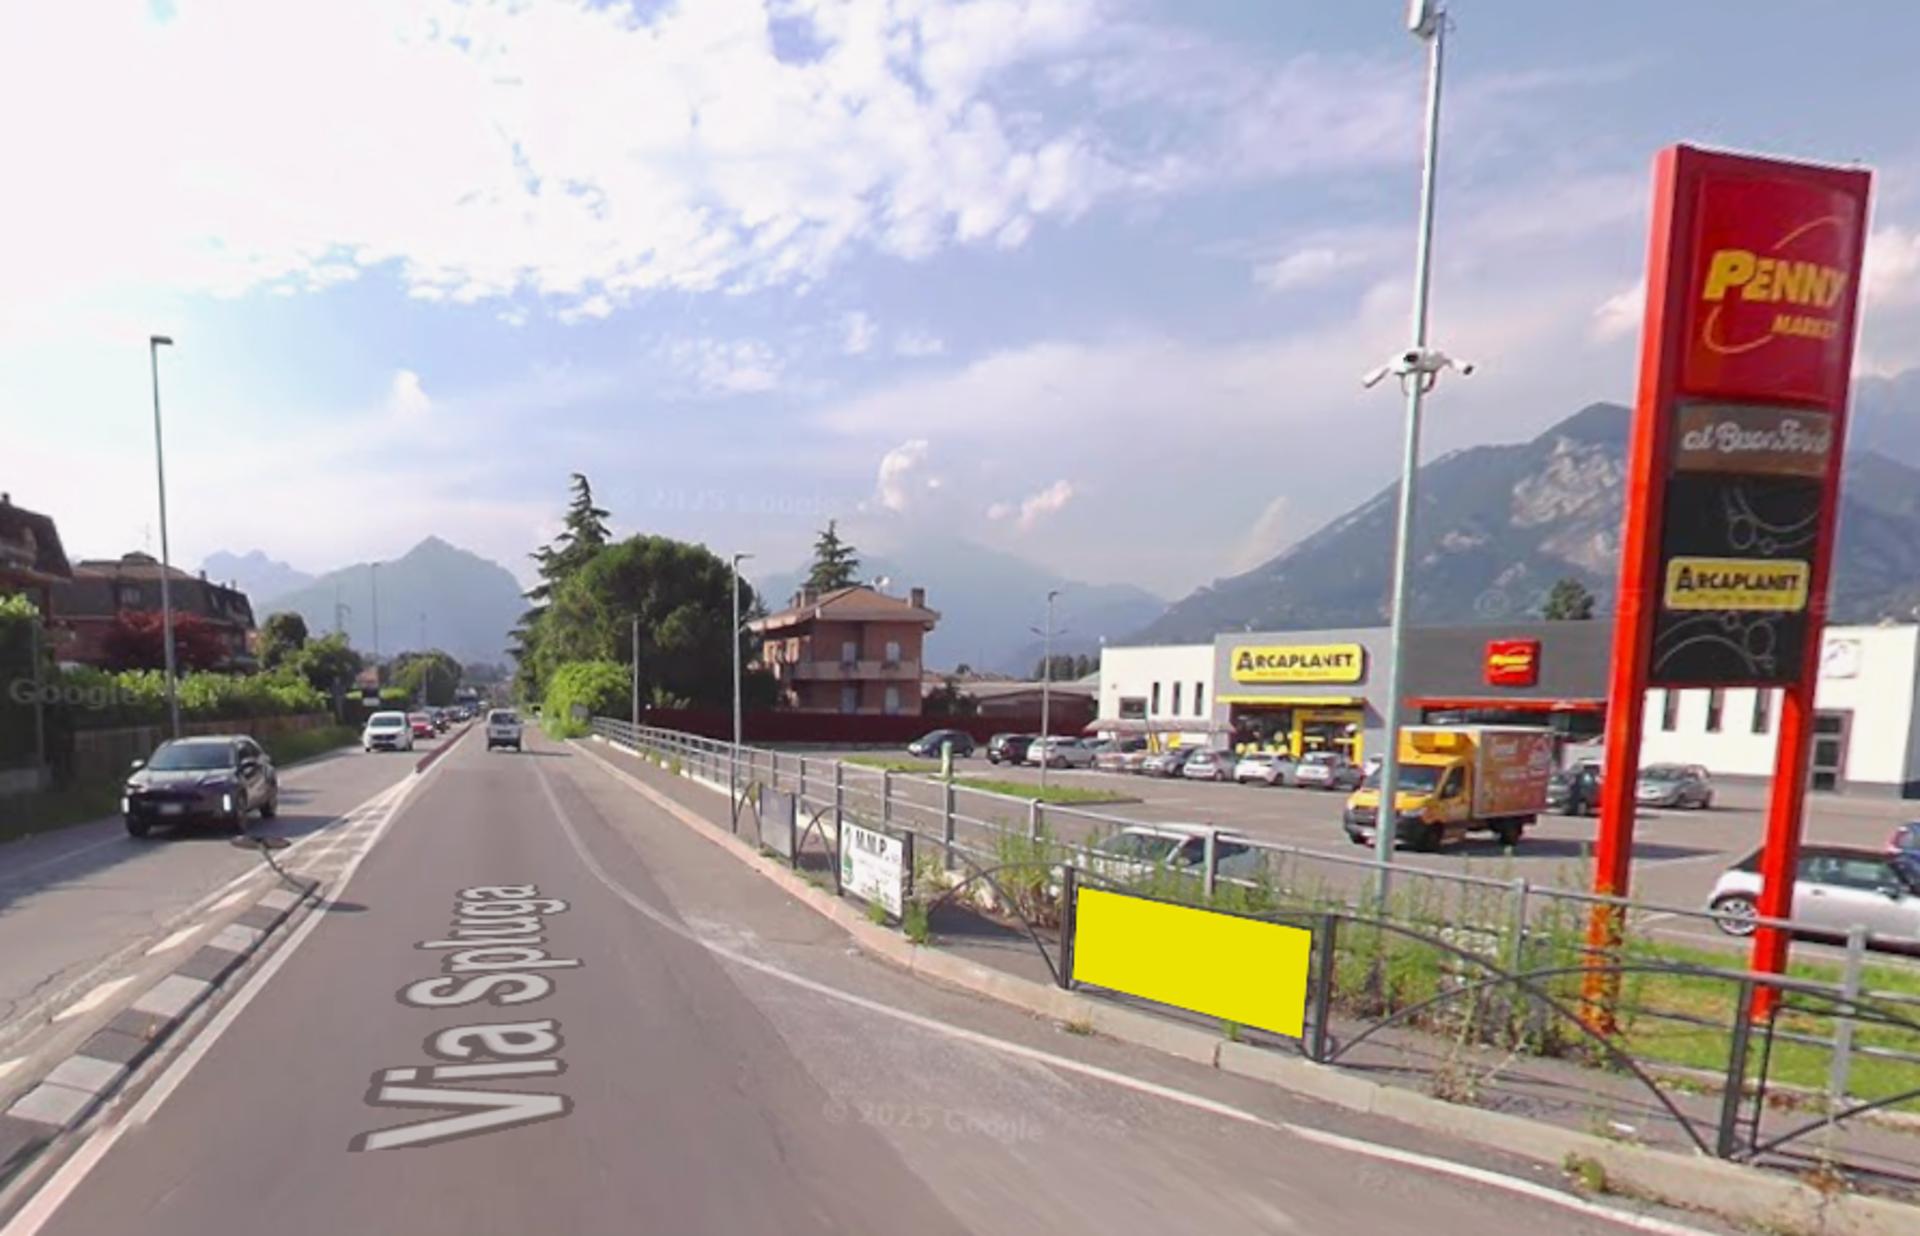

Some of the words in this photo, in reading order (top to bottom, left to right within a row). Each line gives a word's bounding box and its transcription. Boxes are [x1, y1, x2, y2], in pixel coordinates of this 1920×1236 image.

[1702, 250, 1849, 308] PENNY
[1676, 565, 1801, 592] ARCAPLANET
[1236, 650, 1353, 671] ARCAPLANET
